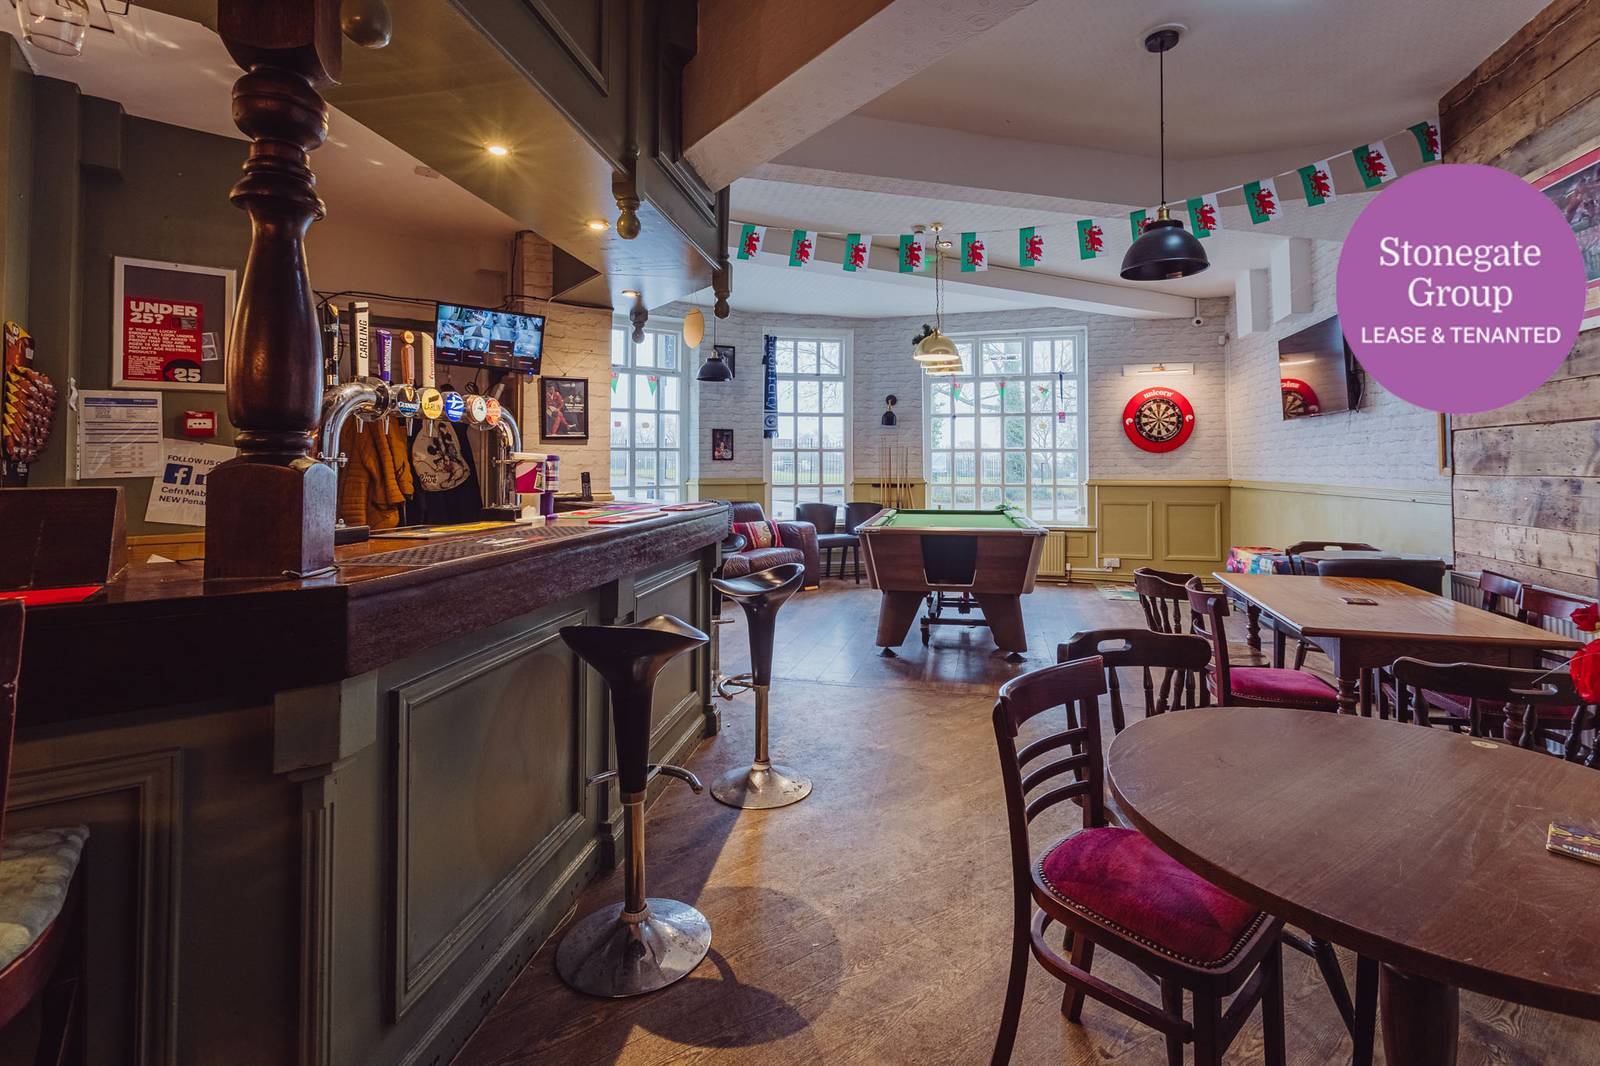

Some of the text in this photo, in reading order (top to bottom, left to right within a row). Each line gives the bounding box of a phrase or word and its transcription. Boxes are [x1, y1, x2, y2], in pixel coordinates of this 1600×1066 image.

[130, 301, 198, 317] UNDER
[130, 312, 164, 325] 25?
[359, 319, 368, 359] CARLING
[174, 368, 201, 382] 25
[1143, 389, 1175, 399] unicorn
[167, 455, 203, 465] FOLLOW
[204, 458, 215, 466] US
[161, 486, 183, 495] Cefn
[159, 495, 181, 503] NEW
